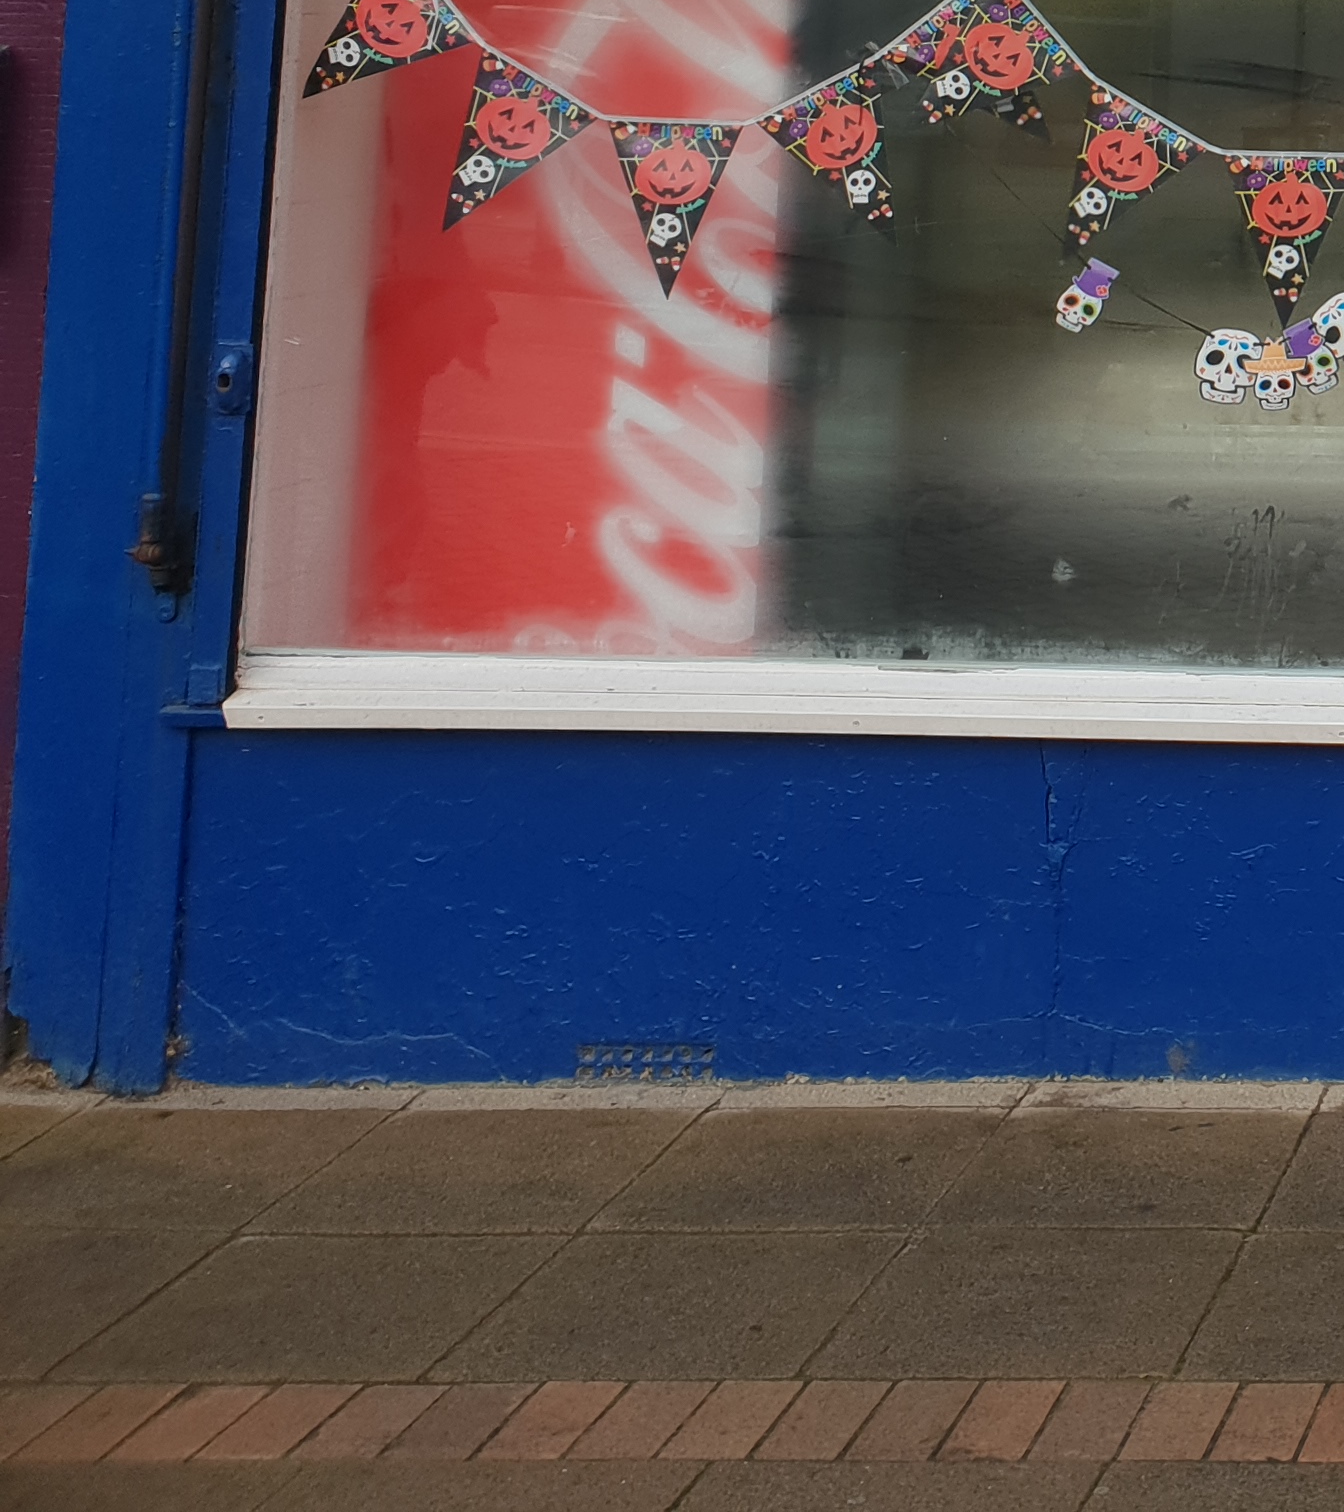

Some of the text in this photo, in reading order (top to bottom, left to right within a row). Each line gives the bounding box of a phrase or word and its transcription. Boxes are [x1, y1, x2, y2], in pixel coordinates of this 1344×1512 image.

[503, 64, 578, 120] Halloween
[637, 122, 723, 141] Halloween
[1109, 96, 1187, 152] Halloween
[1250, 155, 1337, 173] Halloween
